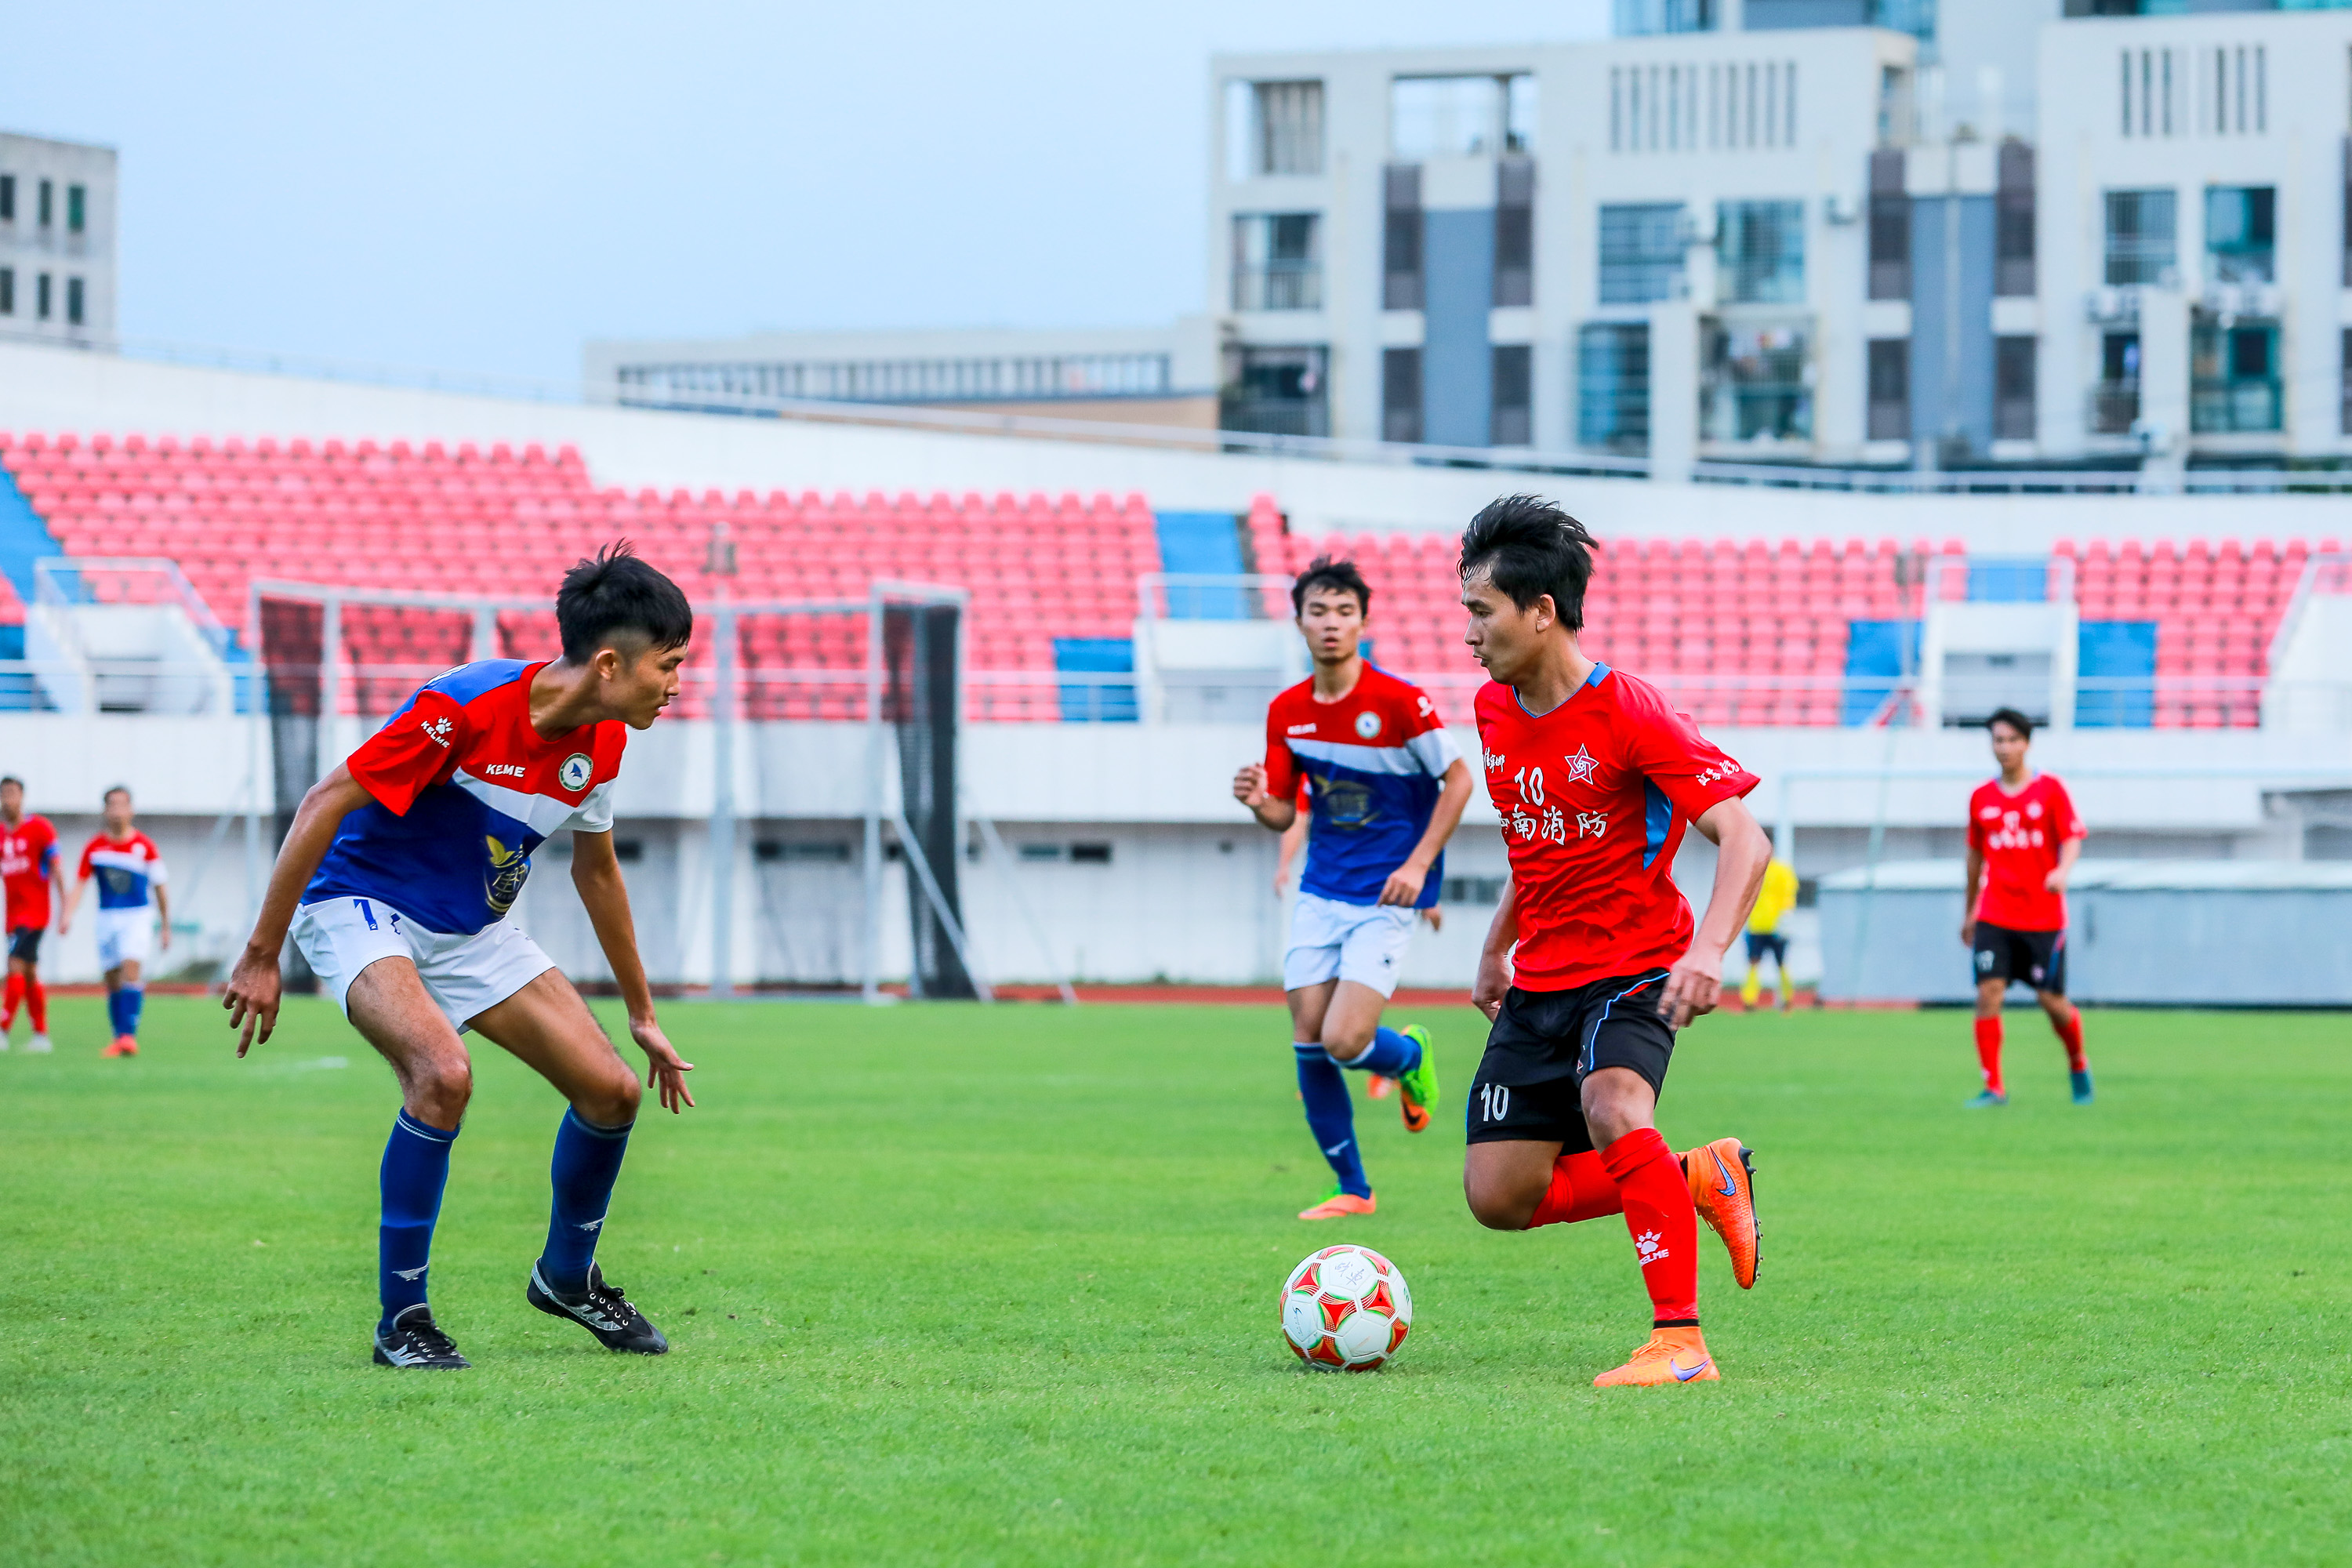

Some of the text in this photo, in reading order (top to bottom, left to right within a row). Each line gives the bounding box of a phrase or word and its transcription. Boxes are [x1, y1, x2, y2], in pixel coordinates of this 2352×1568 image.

[420, 720, 450, 748] KELME
[1514, 766, 1544, 806] 10
[1499, 804, 1609, 846] 南消防
[1480, 1083, 1509, 1121] 10
